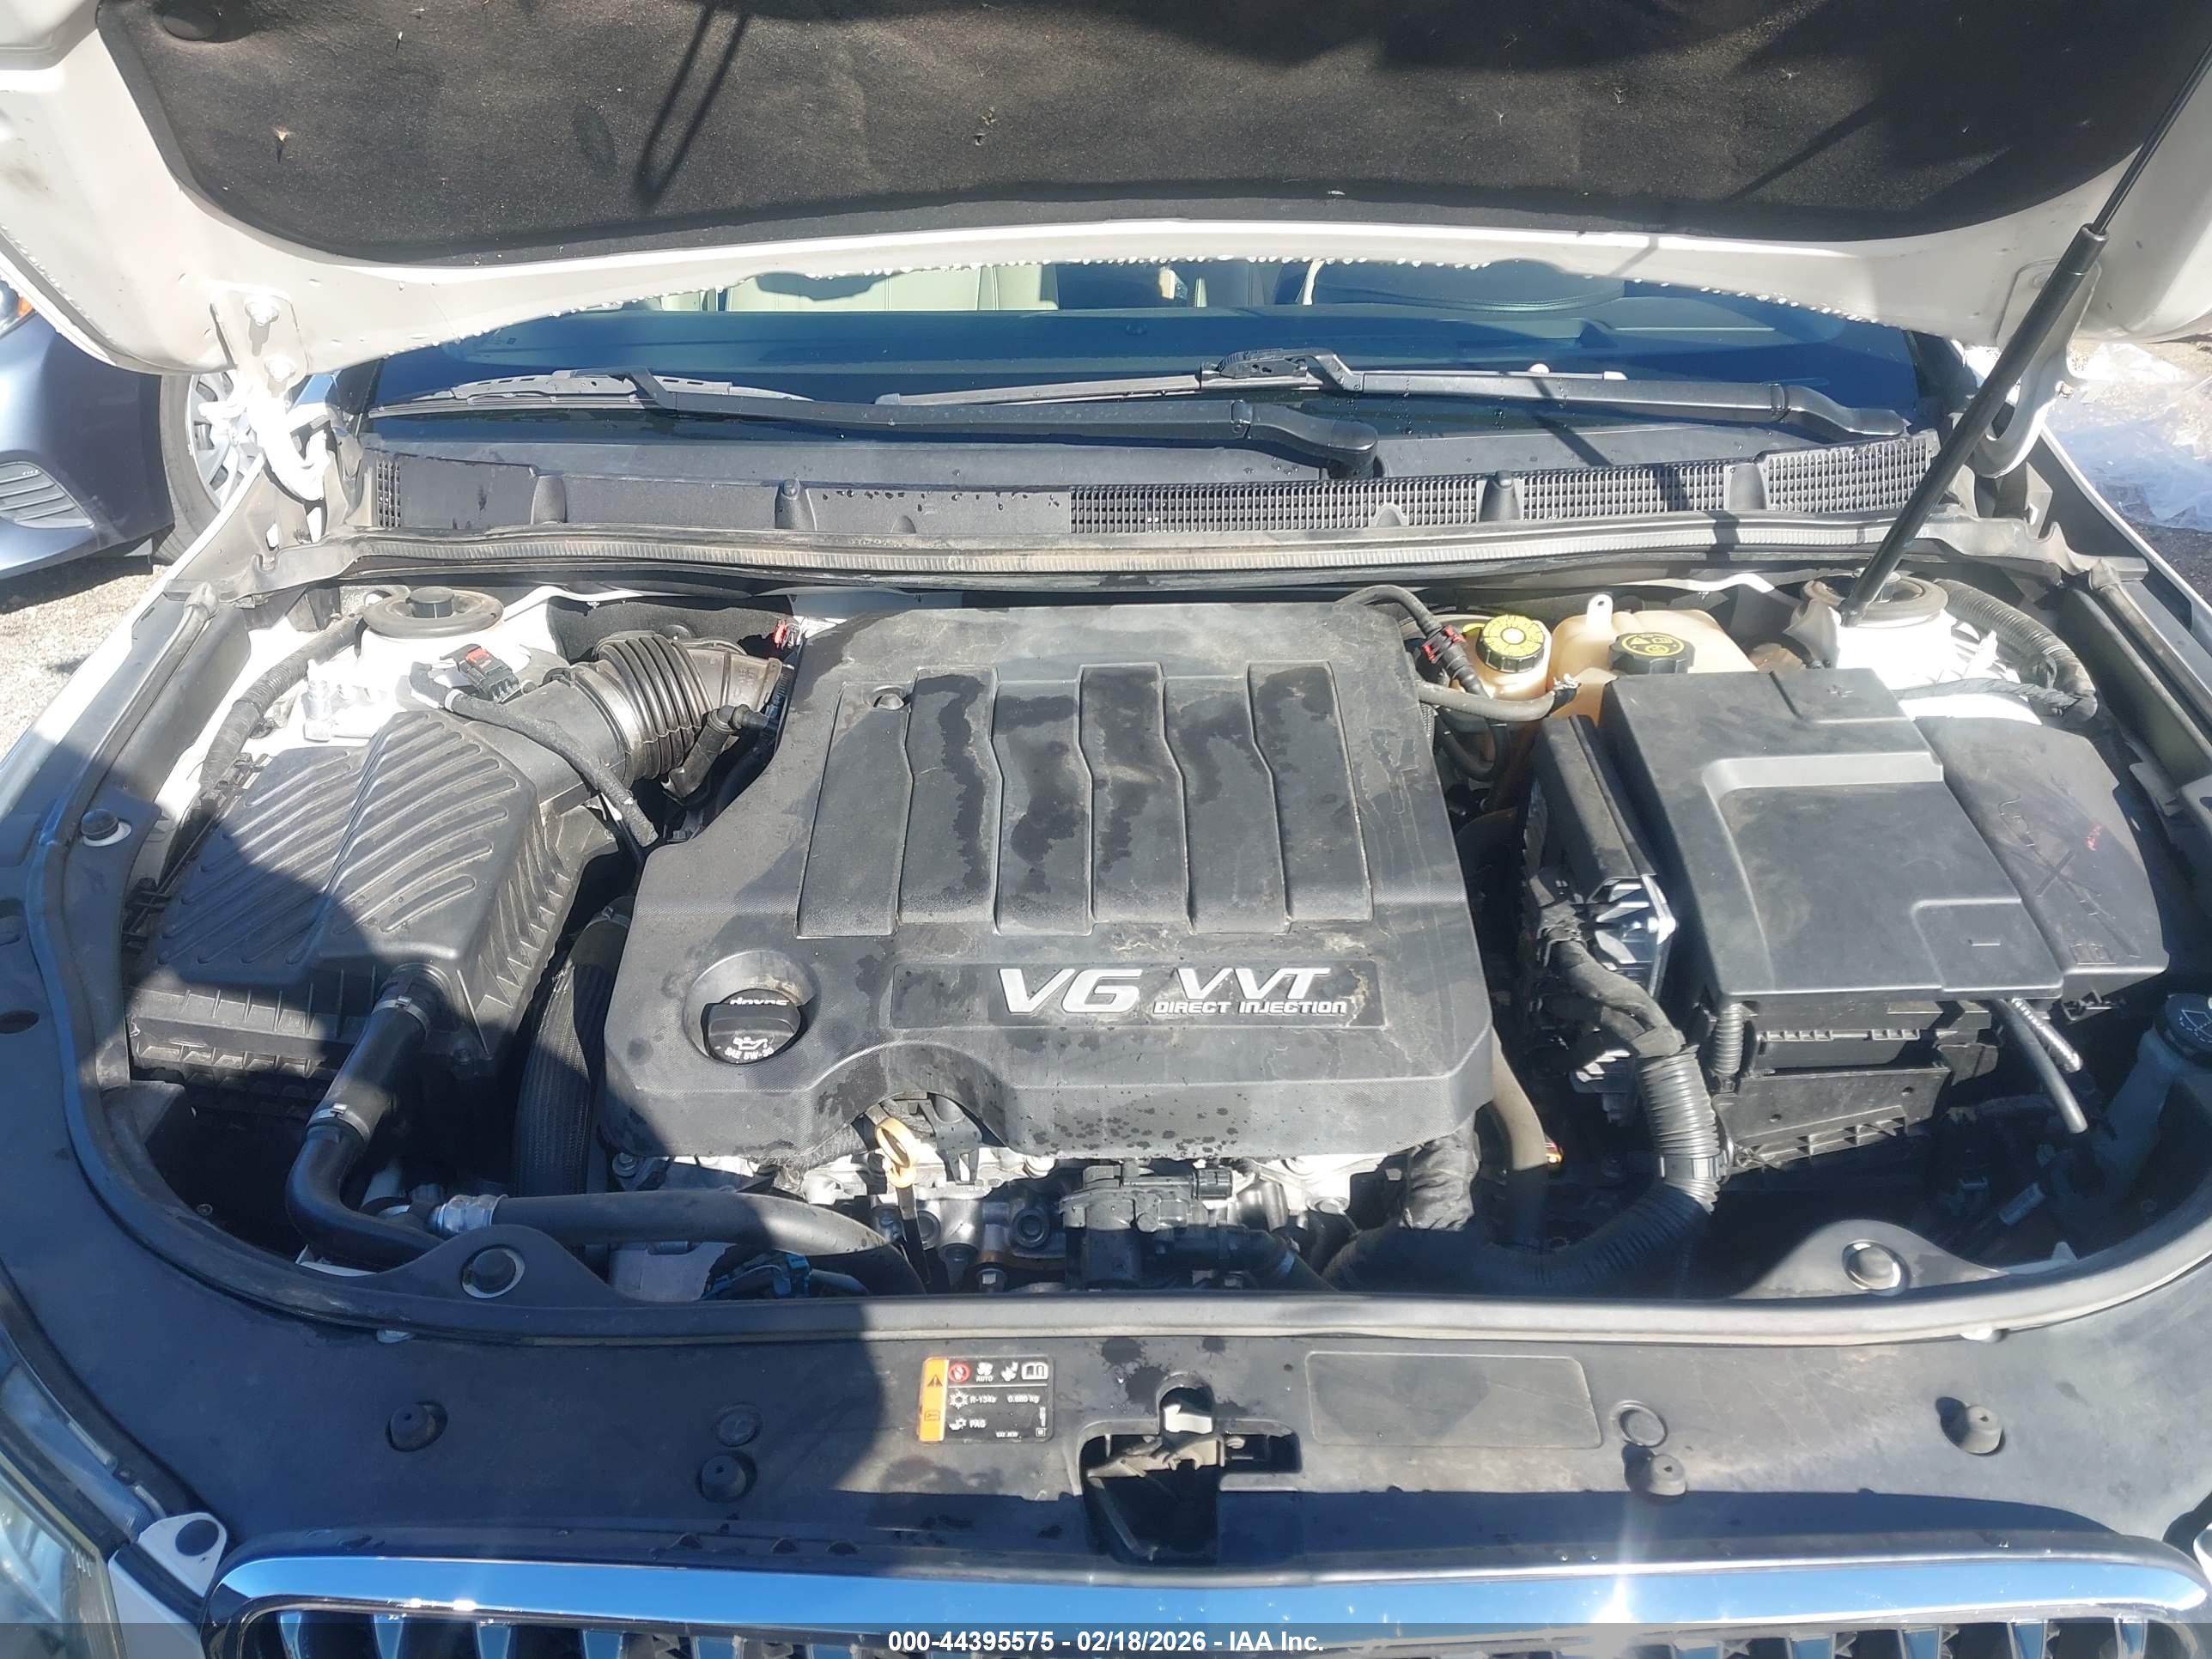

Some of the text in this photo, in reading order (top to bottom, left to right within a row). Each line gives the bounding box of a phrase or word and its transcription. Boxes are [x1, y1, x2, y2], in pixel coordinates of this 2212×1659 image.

[999, 968, 1332, 1014] V6 VVT
[1153, 1001, 1348, 1014] DIRECT INJECTION
[724, 1047, 742, 1059] SAE
[969, 1419, 987, 1429] PAG
